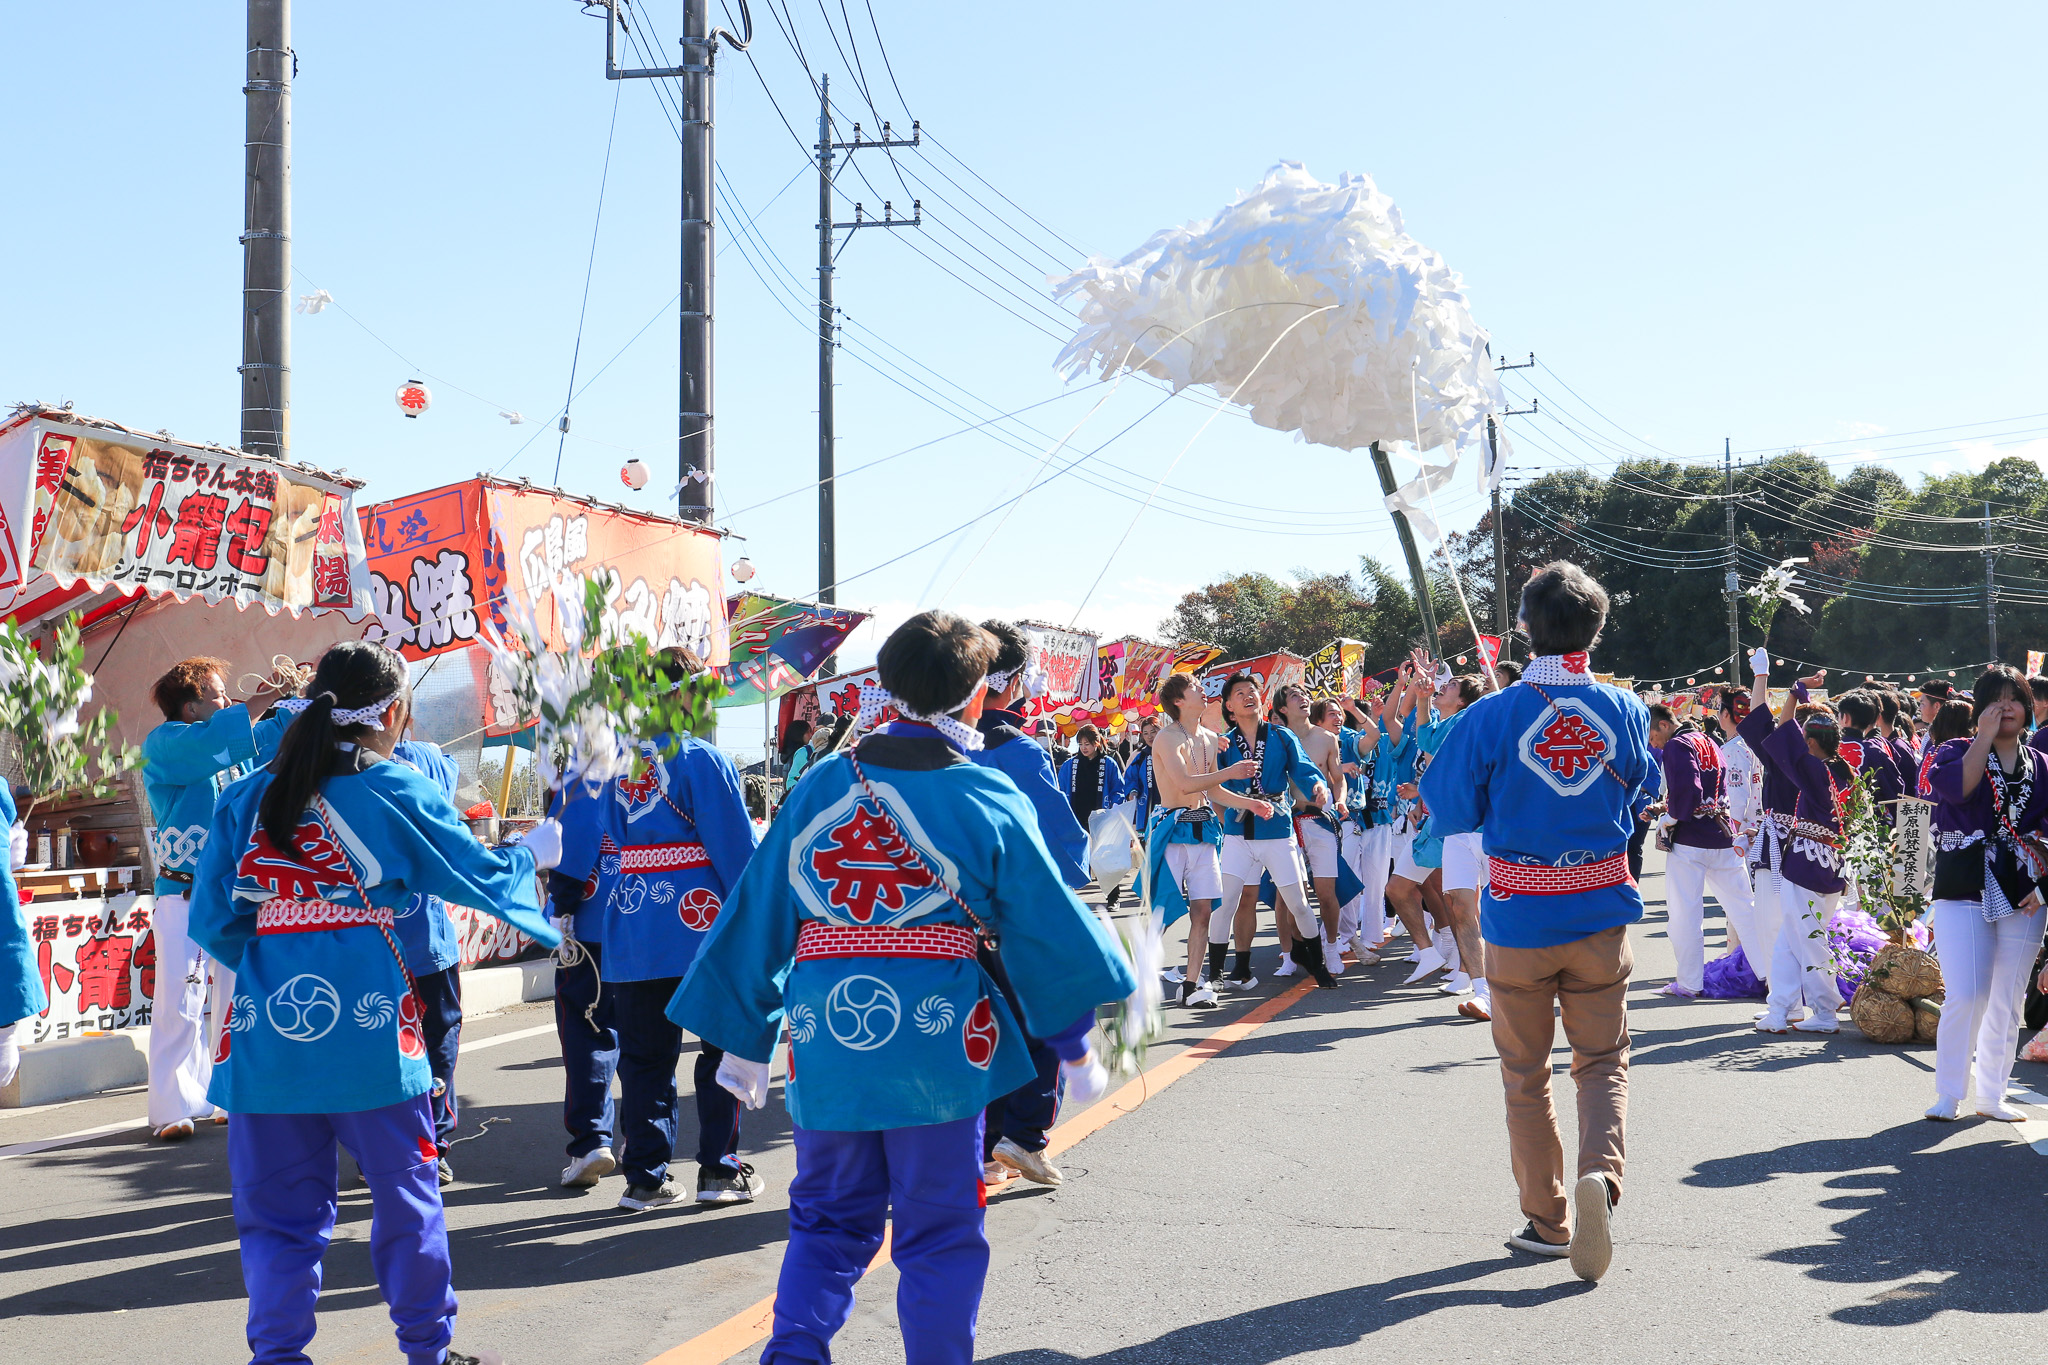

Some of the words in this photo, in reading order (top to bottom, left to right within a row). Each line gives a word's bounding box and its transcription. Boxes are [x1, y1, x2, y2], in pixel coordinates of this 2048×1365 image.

[401, 387, 426, 409] 祭
[142, 448, 279, 502] 福ちゃん本舗
[121, 481, 273, 576] 小籠包
[315, 503, 350, 597] 本場
[113, 558, 262, 594] ショーロンポー
[1534, 714, 1606, 778] 祭
[811, 803, 936, 924] 祭
[32, 907, 156, 942] 福ちゃん本
